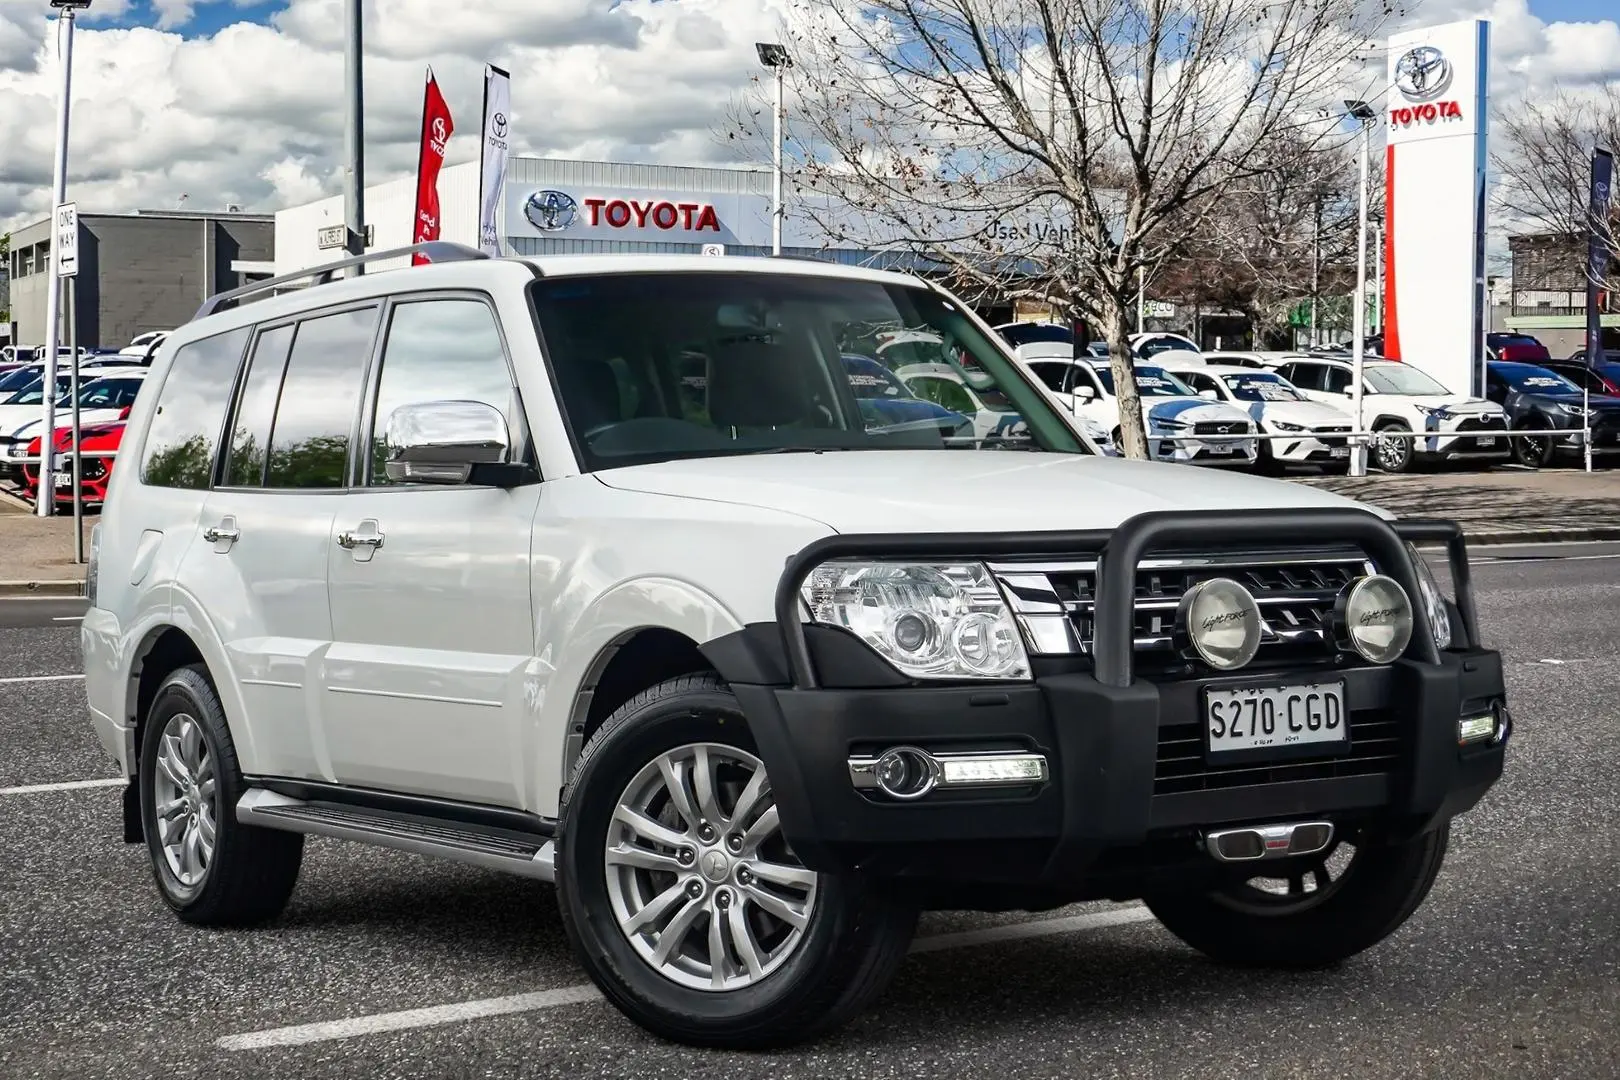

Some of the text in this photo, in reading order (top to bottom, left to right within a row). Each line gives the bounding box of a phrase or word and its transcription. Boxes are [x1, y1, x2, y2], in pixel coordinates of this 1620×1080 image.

[1389, 101, 1462, 125] TOYOTA
[60, 209, 74, 228] ONE
[584, 199, 721, 232] TOYOTA
[59, 231, 75, 249] WAY
